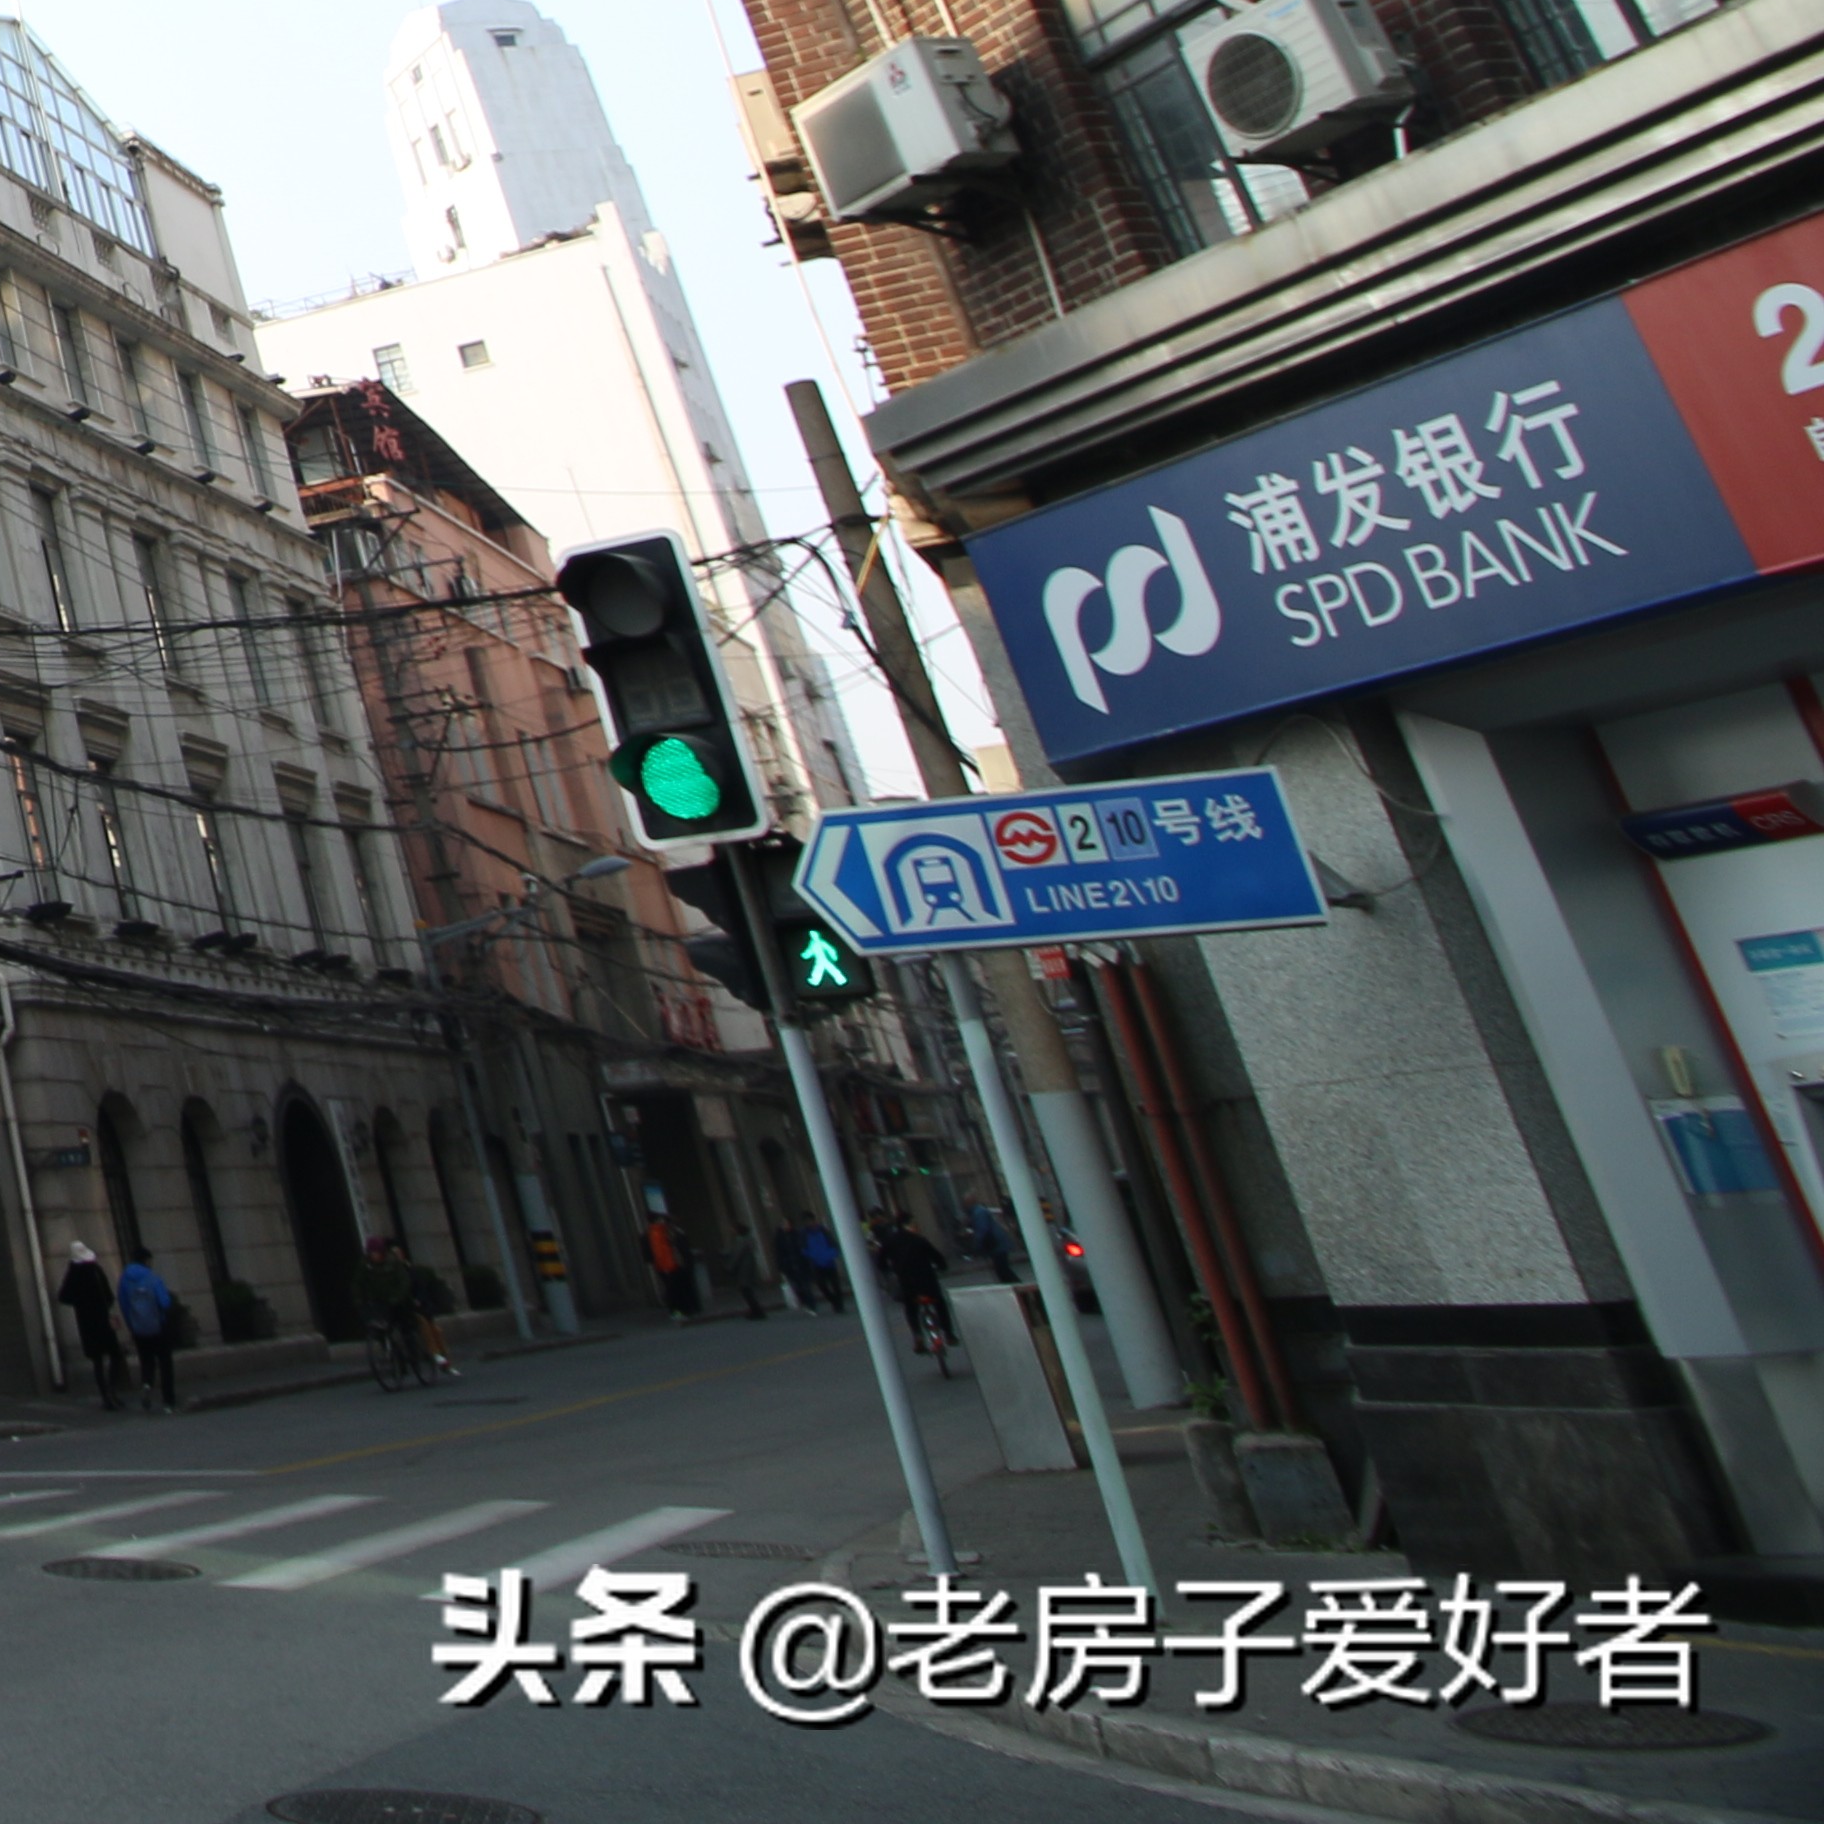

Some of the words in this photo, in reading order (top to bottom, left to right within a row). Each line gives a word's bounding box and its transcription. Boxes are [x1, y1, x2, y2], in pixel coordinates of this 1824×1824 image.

[1226, 381, 1580, 574] 浦发银行
[1275, 563, 1404, 647] SPD
[1407, 492, 1628, 609] BANK
[1069, 817, 1096, 850] 2
[1108, 809, 1146, 847] 10
[1154, 794, 1263, 846] 号线
[1751, 810, 1807, 831] CRS
